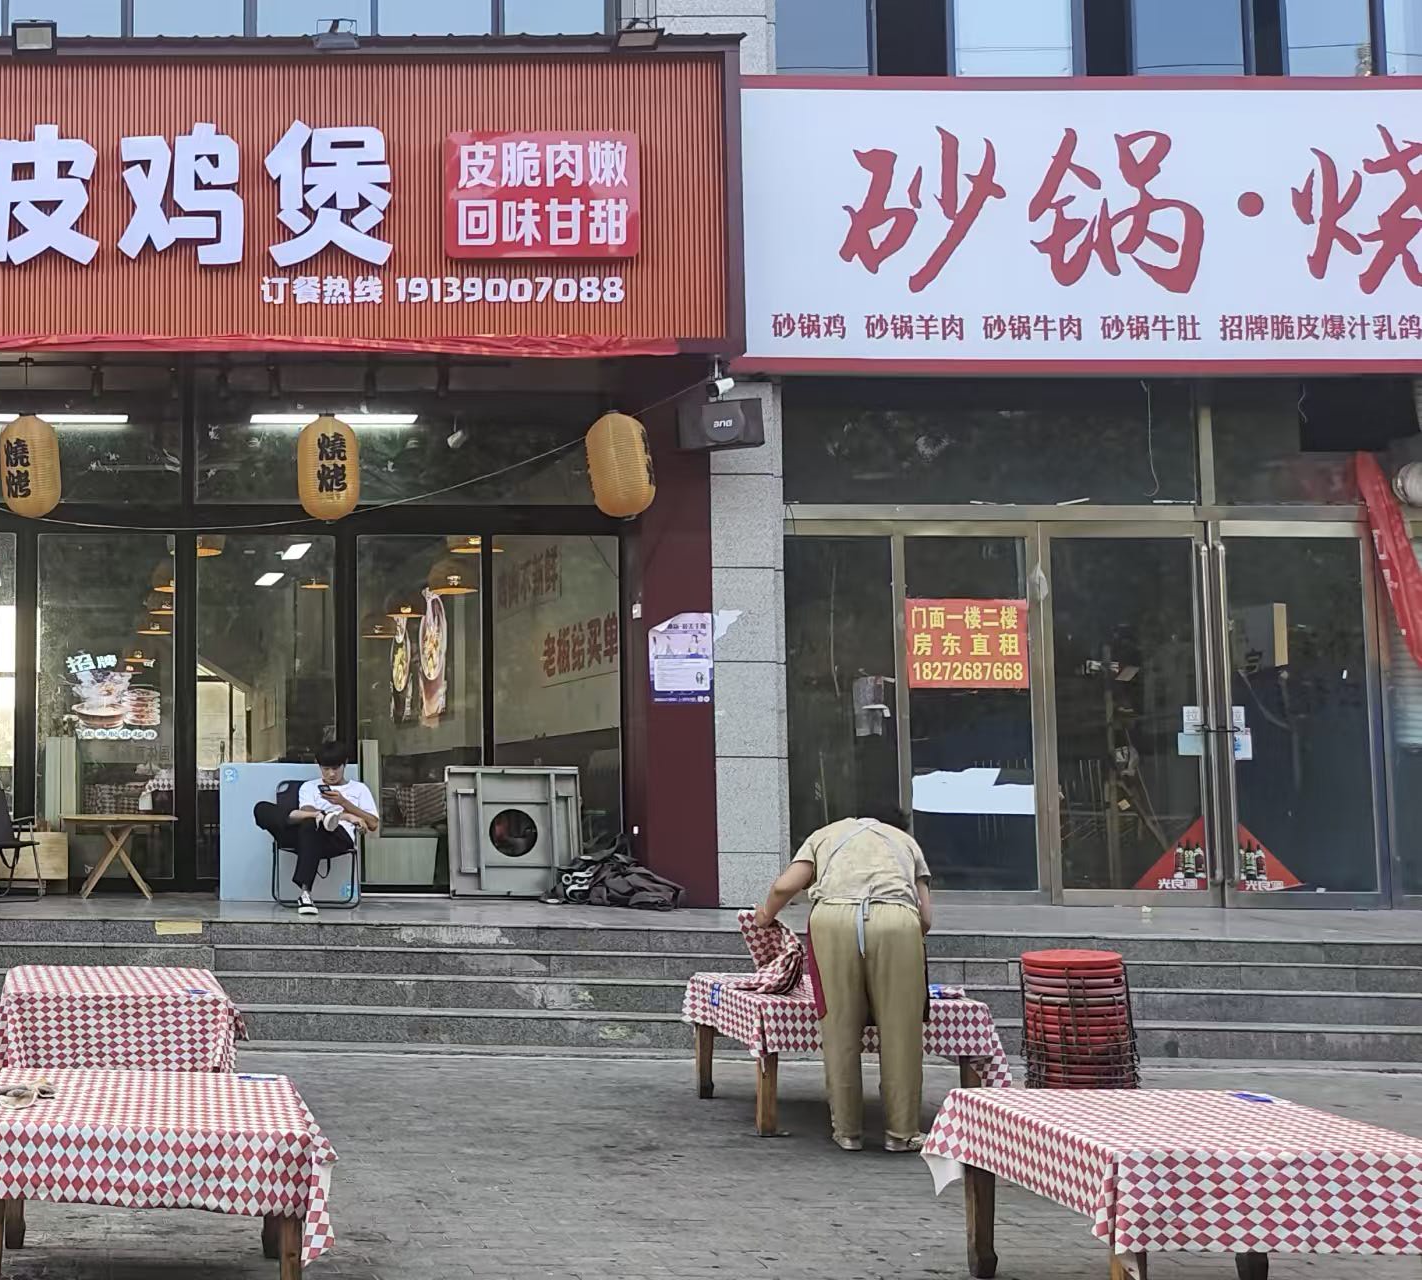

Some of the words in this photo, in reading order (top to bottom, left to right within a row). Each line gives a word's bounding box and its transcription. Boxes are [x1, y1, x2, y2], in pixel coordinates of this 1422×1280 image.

[458, 140, 629, 189] 皮脆肉嫩
[458, 198, 629, 246] 回味甘甜
[261, 276, 384, 305] 订餐热线
[395, 276, 625, 303] 19139007088
[772, 313, 846, 340] 砂锅鸡
[865, 314, 964, 341] 砂锅羊肉
[982, 314, 1082, 341] 砂锅牛肉
[1100, 314, 1201, 341] 砂锅牛肚
[911, 606, 1018, 629] 门面一楼二楼
[913, 633, 1020, 656] 房东直租
[913, 662, 1023, 681] 18272687668
